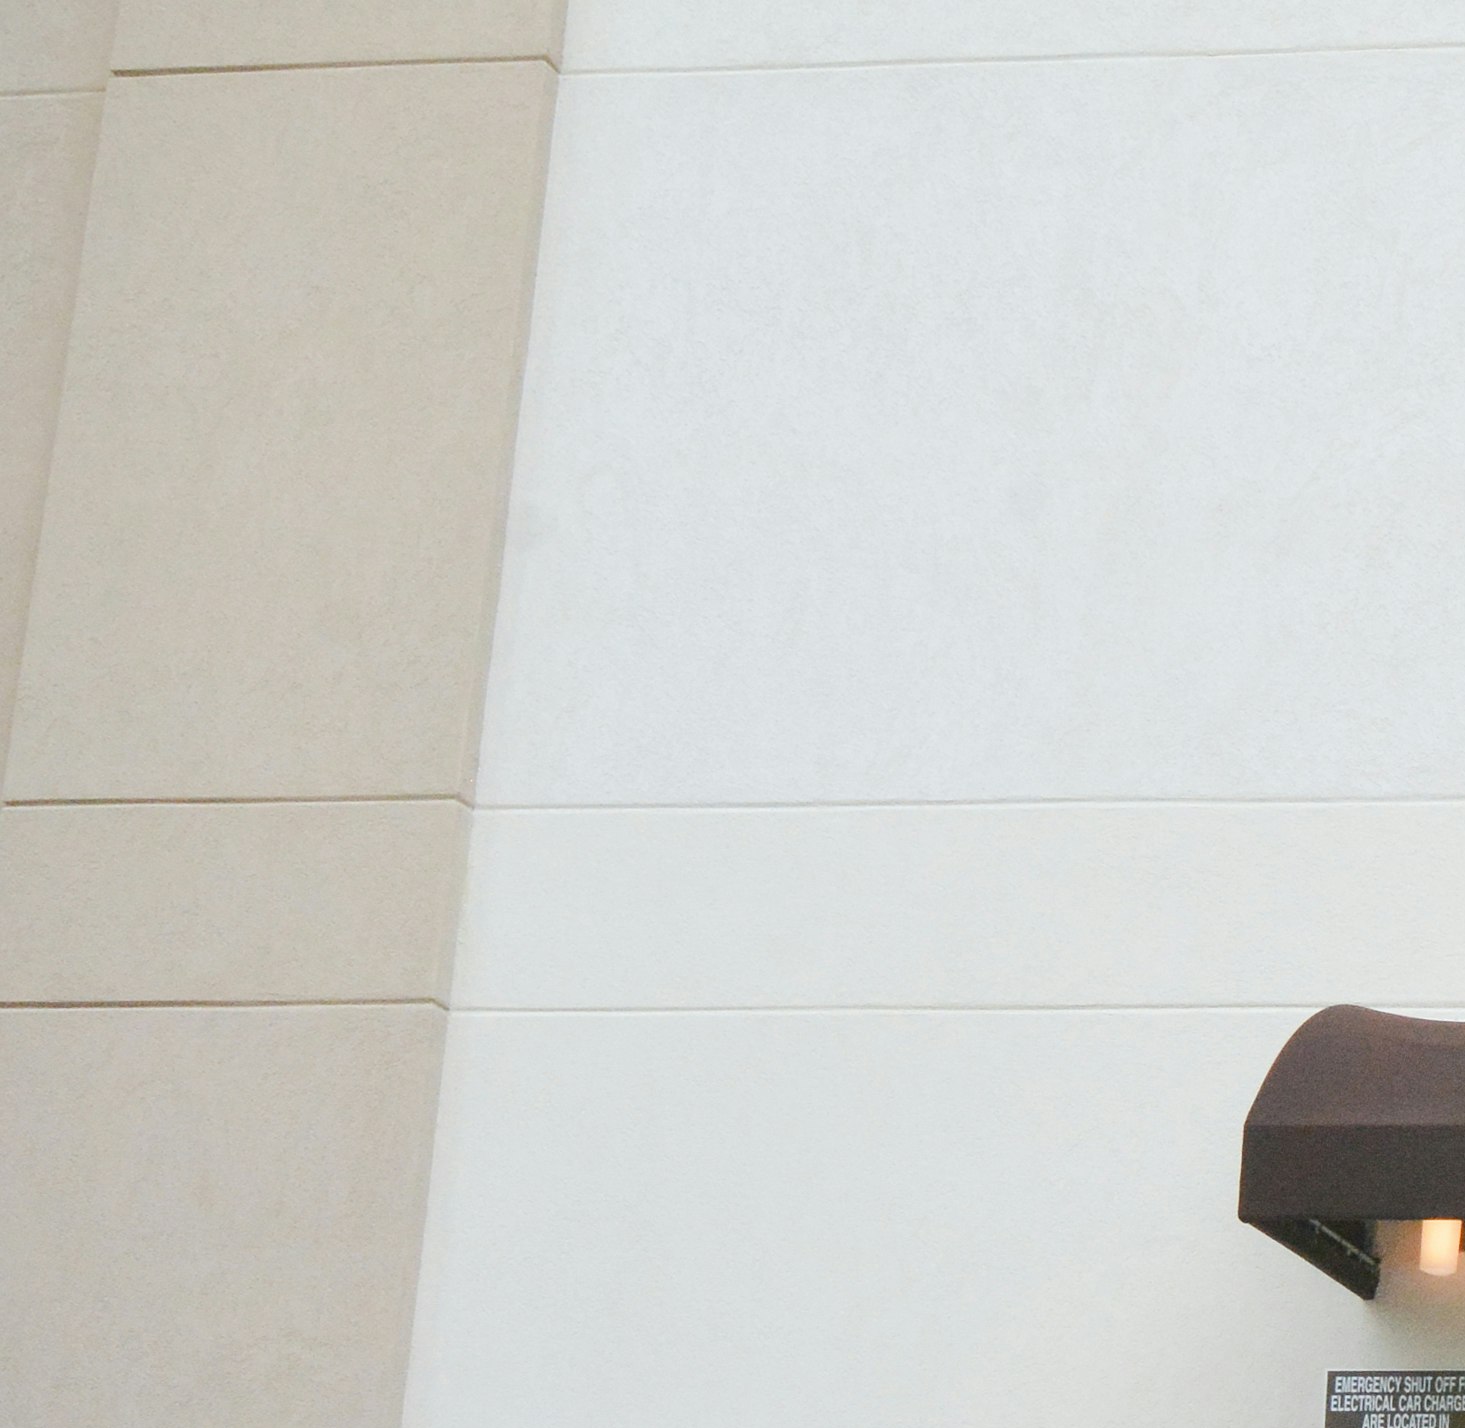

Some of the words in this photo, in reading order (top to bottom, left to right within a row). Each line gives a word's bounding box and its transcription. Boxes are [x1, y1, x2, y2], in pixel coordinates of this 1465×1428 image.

[1335, 1376, 1401, 1393] EMERGENCY
[1404, 1377, 1432, 1393] SHUT
[1435, 1377, 1456, 1393] OFF
[1331, 1395, 1395, 1411] ELECTRICAL
[1398, 1395, 1421, 1411] CAR
